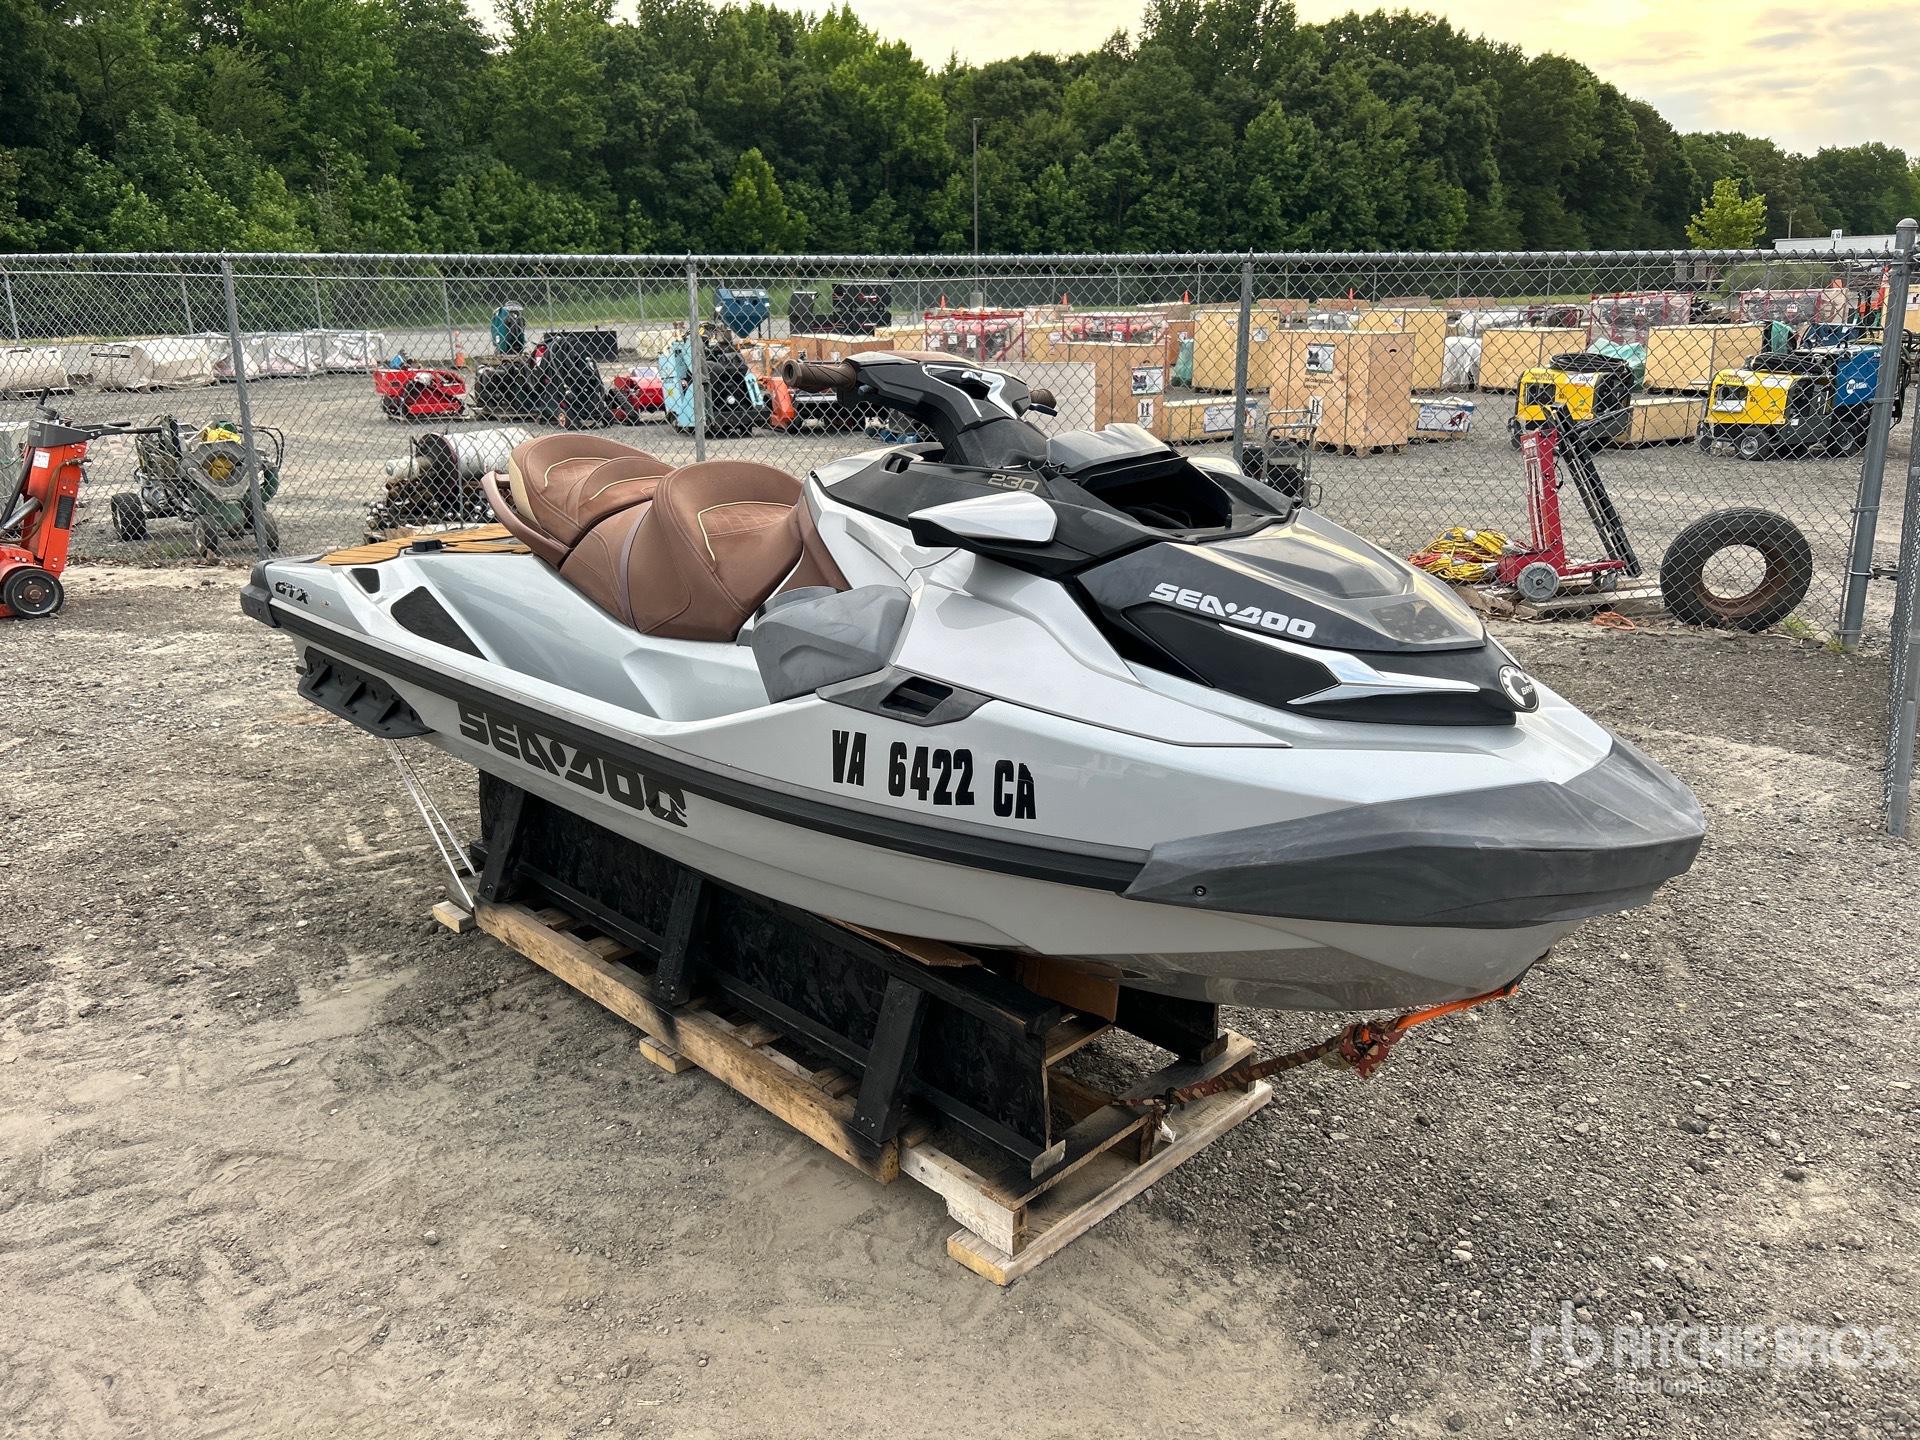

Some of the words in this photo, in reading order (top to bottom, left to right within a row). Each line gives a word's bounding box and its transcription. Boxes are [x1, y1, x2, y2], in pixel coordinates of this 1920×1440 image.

[987, 473, 1039, 493] 230
[275, 581, 309, 605] GTX
[1520, 684, 1534, 696] BRP
[832, 729, 867, 787] VA
[888, 741, 976, 806] 6422
[993, 759, 1037, 820] CA
